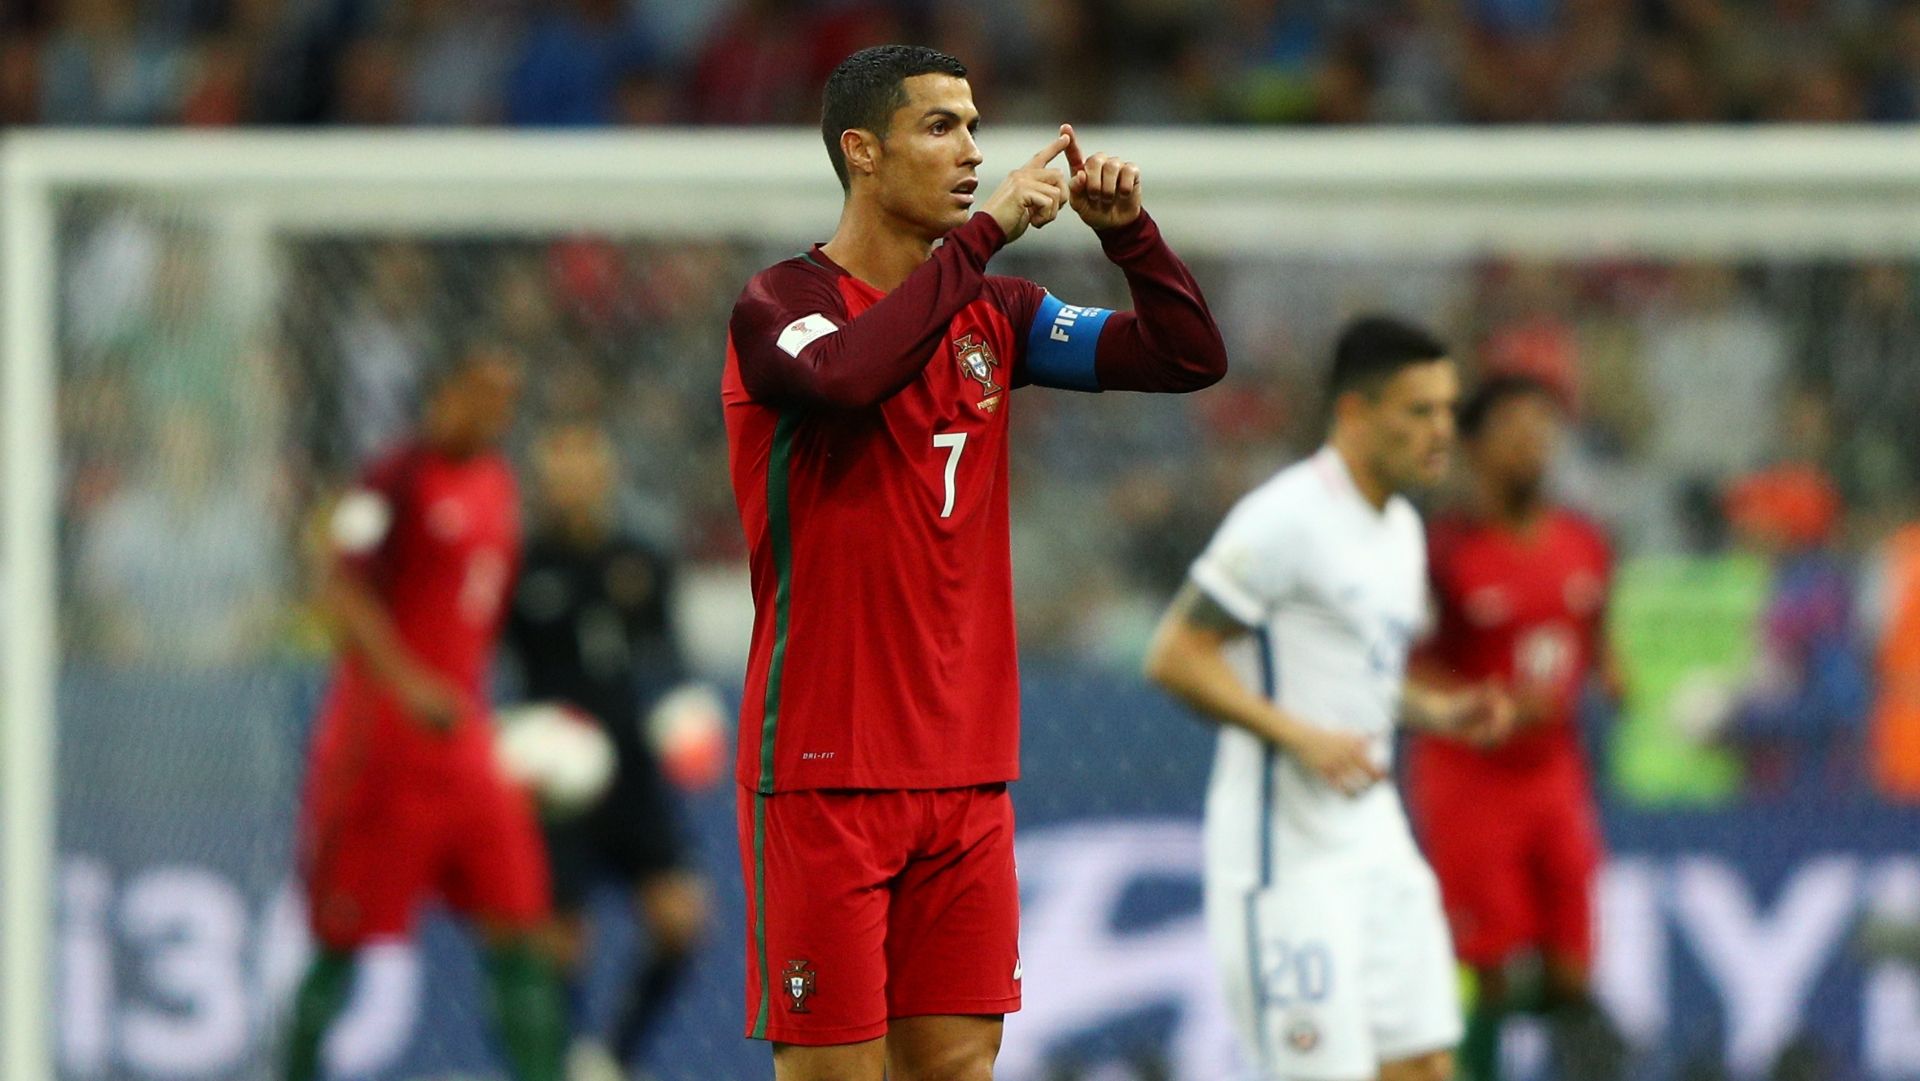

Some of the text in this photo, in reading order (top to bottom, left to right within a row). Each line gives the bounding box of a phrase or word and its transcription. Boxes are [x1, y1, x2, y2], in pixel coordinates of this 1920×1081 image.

[933, 432, 968, 518] 7
[802, 752, 835, 760] DRI-FIT
[1256, 938, 1335, 1006] 20
